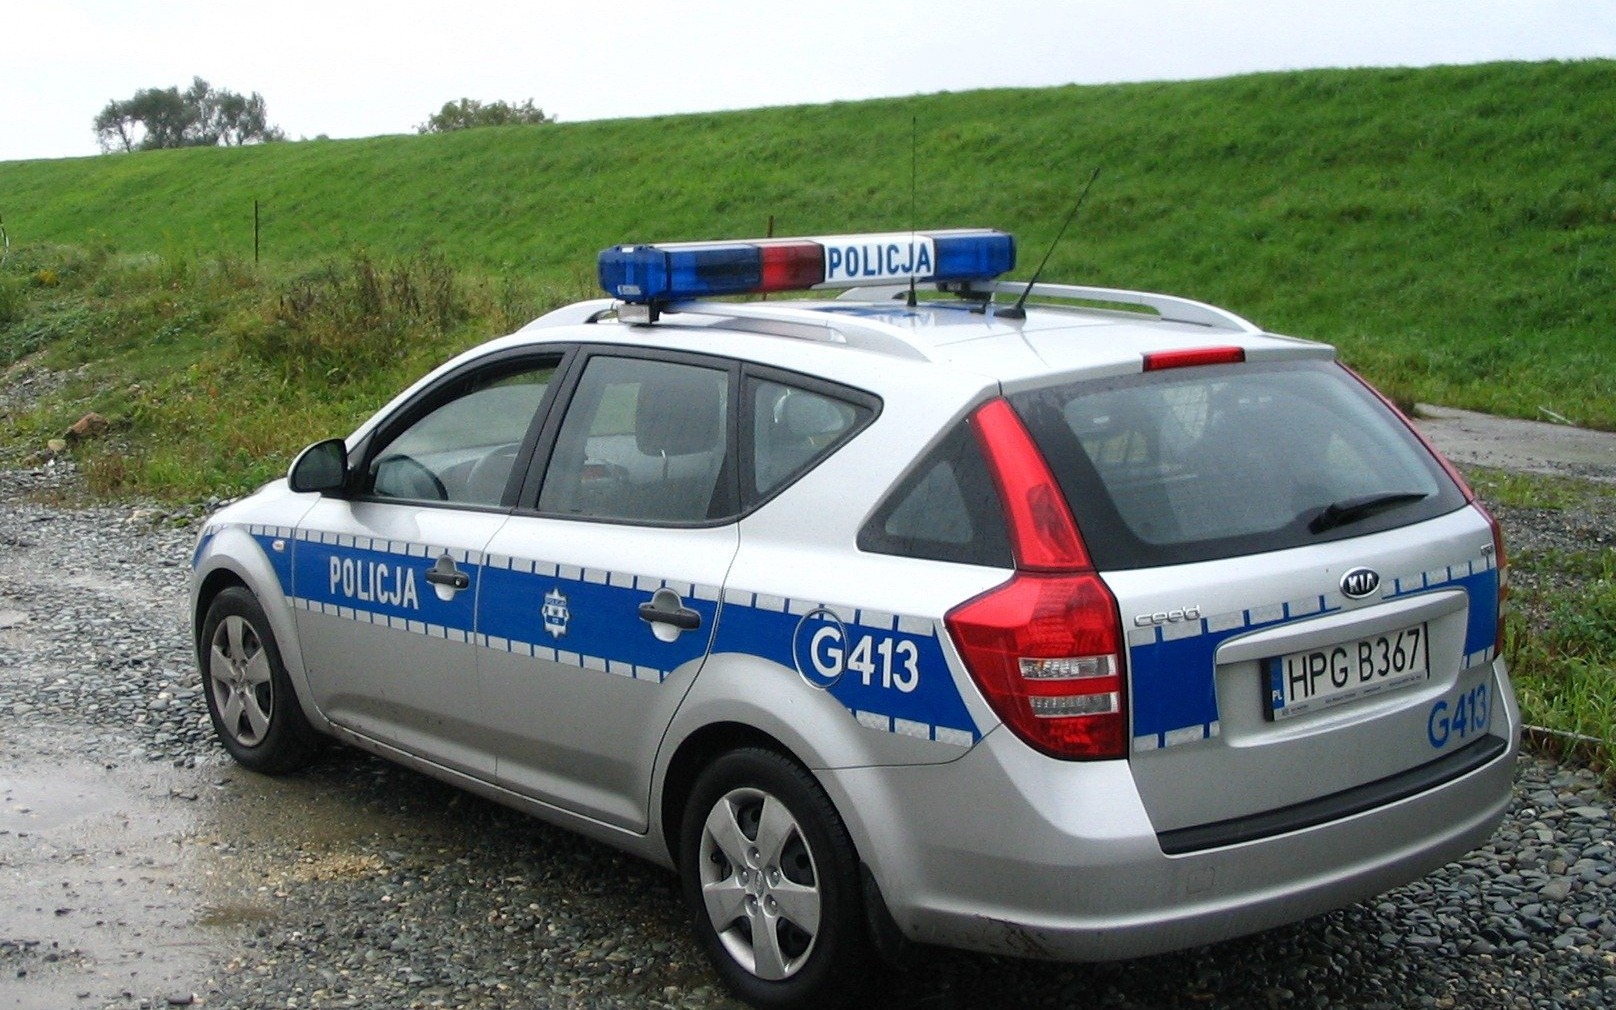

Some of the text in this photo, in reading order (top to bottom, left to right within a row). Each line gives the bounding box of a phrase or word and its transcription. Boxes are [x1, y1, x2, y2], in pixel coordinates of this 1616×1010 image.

[828, 242, 931, 279] POLICJA
[329, 555, 419, 611] POLICJA
[1347, 572, 1376, 593] KIA
[810, 625, 919, 694] G413
[1288, 627, 1421, 701] HPG B367
[1272, 688, 1283, 701] PL
[1427, 683, 1487, 750] G413
